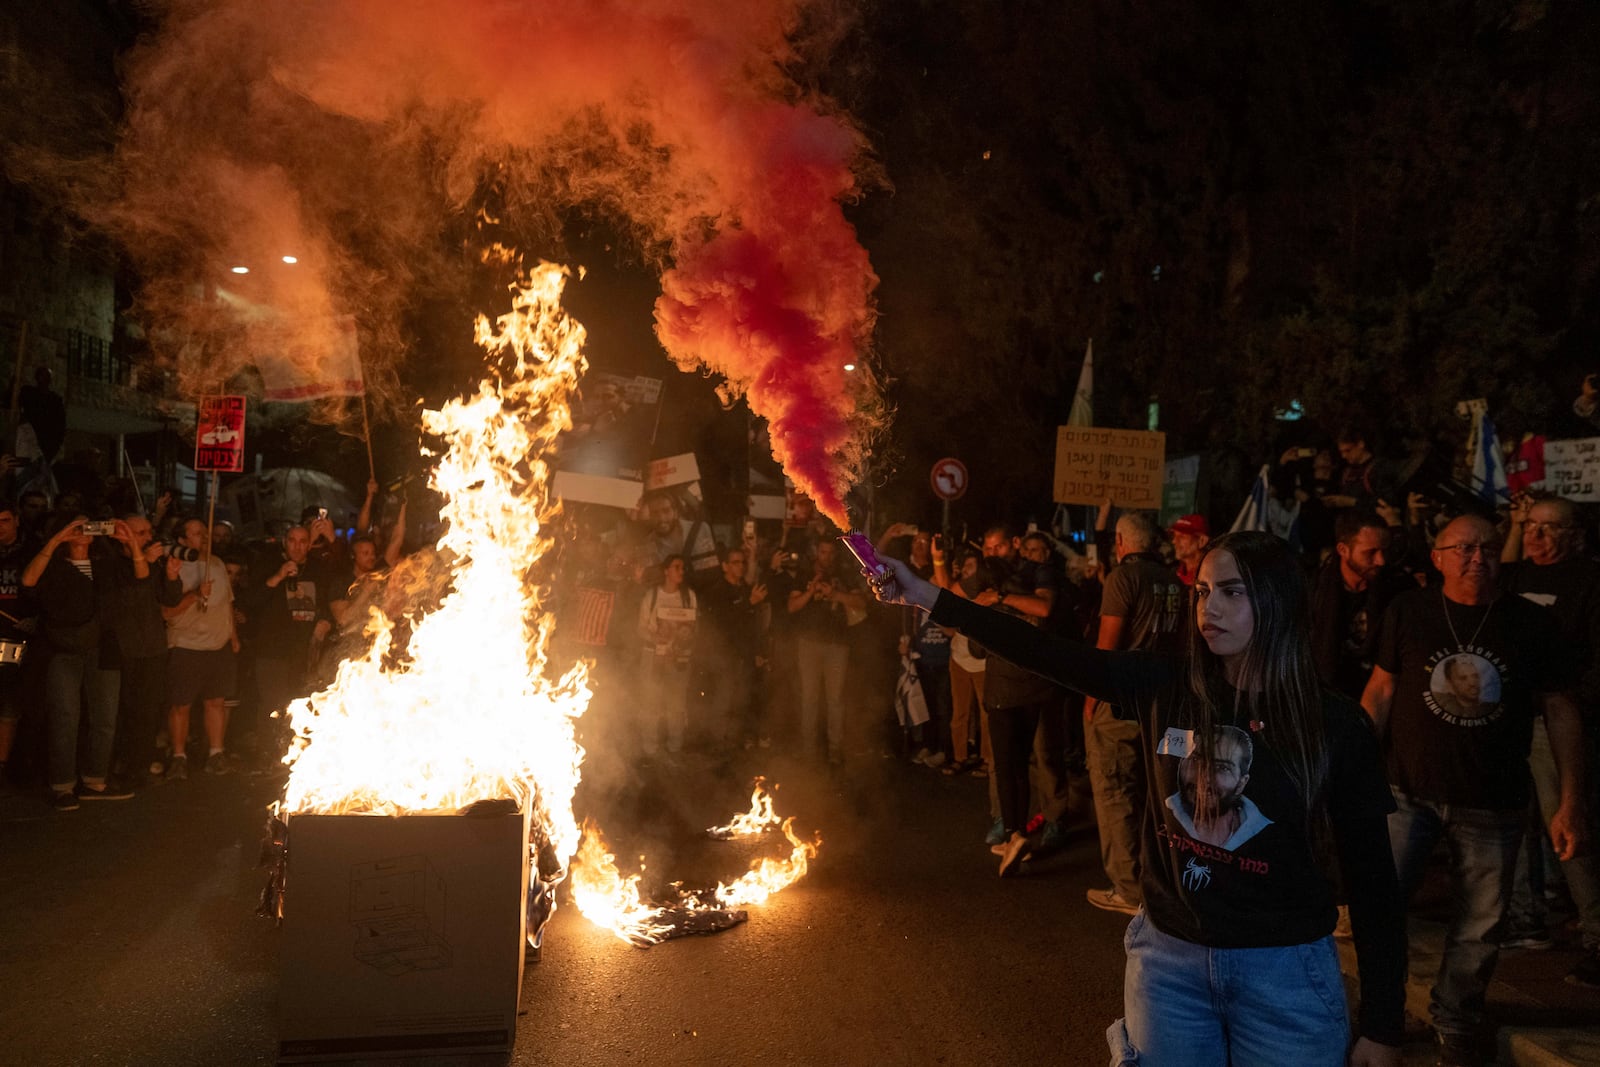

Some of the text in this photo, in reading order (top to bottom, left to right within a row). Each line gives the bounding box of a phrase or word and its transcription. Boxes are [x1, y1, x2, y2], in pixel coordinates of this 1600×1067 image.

[1121, 436, 1160, 449] הותר
[1100, 453, 1135, 470] ביטחון
[1138, 457, 1159, 470] שר
[1099, 470, 1110, 481] על
[1118, 472, 1149, 484] פוטר
[1063, 481, 1105, 498] מסוכן
[1107, 485, 1153, 502] בוגד
[1429, 648, 1451, 663] TAL
[1422, 690, 1442, 715] BRING
[1441, 712, 1456, 725] TAL
[1458, 717, 1488, 727] HOME
[1238, 856, 1270, 876] מתן
